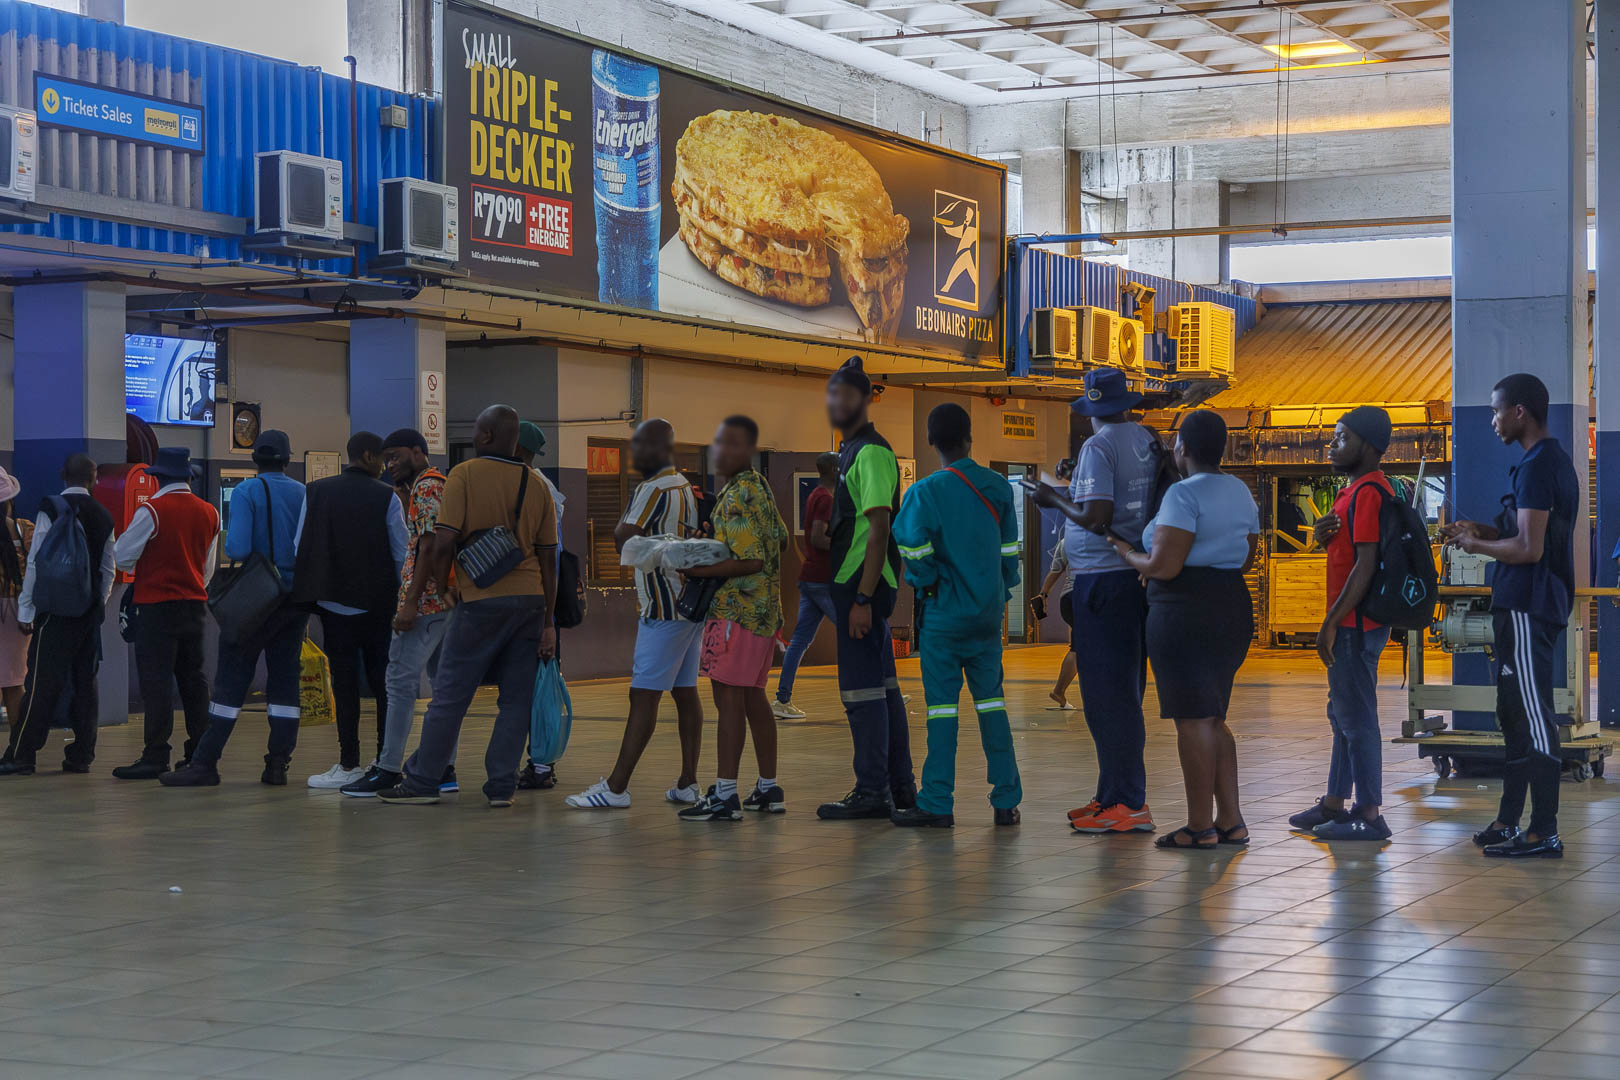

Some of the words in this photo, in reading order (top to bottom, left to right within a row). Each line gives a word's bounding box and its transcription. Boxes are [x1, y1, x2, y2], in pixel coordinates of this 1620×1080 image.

[462, 27, 517, 69] SMALL
[62, 96, 99, 118] Ticket
[101, 104, 133, 124] Sales
[469, 59, 572, 134] TRIPLE-
[146, 116, 177, 130] metrorail
[596, 104, 658, 160] Energade
[529, 202, 569, 233] +FREE
[529, 227, 569, 250] ENERGADE
[916, 305, 966, 338] DEBONAIRS
[968, 316, 993, 343] PIZZA
